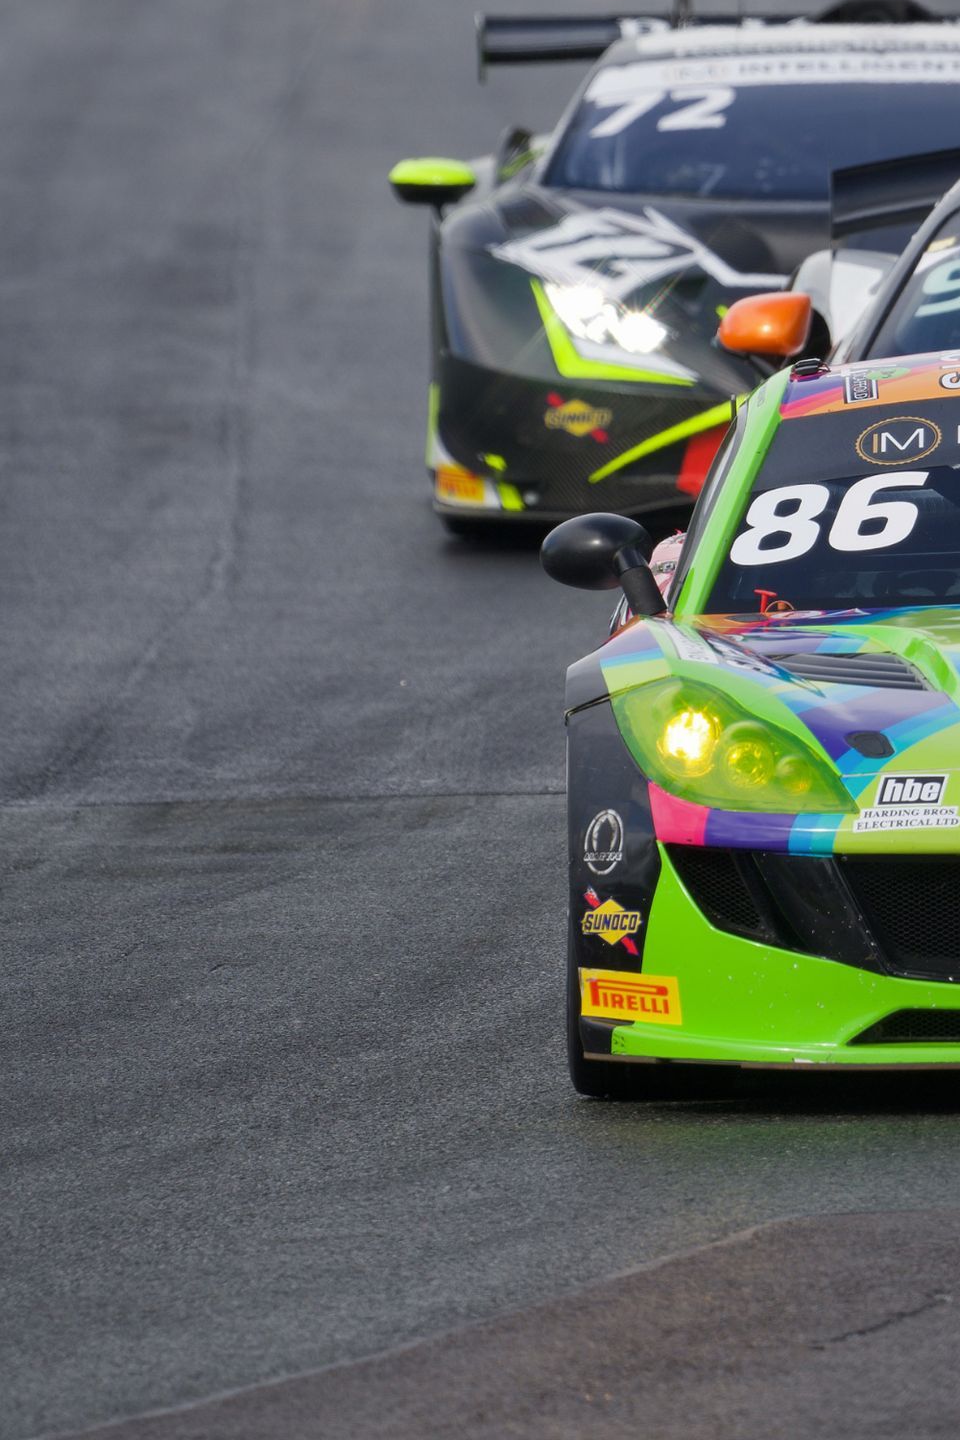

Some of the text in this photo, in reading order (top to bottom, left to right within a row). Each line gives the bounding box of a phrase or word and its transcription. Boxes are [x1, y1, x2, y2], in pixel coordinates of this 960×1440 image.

[590, 86, 735, 138] 72
[730, 471, 930, 566] 86
[881, 778, 941, 802] hbe
[857, 816, 959, 830] ELECTRICAL LTD
[864, 807, 955, 818] HARDING BROS
[584, 912, 639, 931] SUNOCO
[587, 978, 669, 1014] PIRELLI
